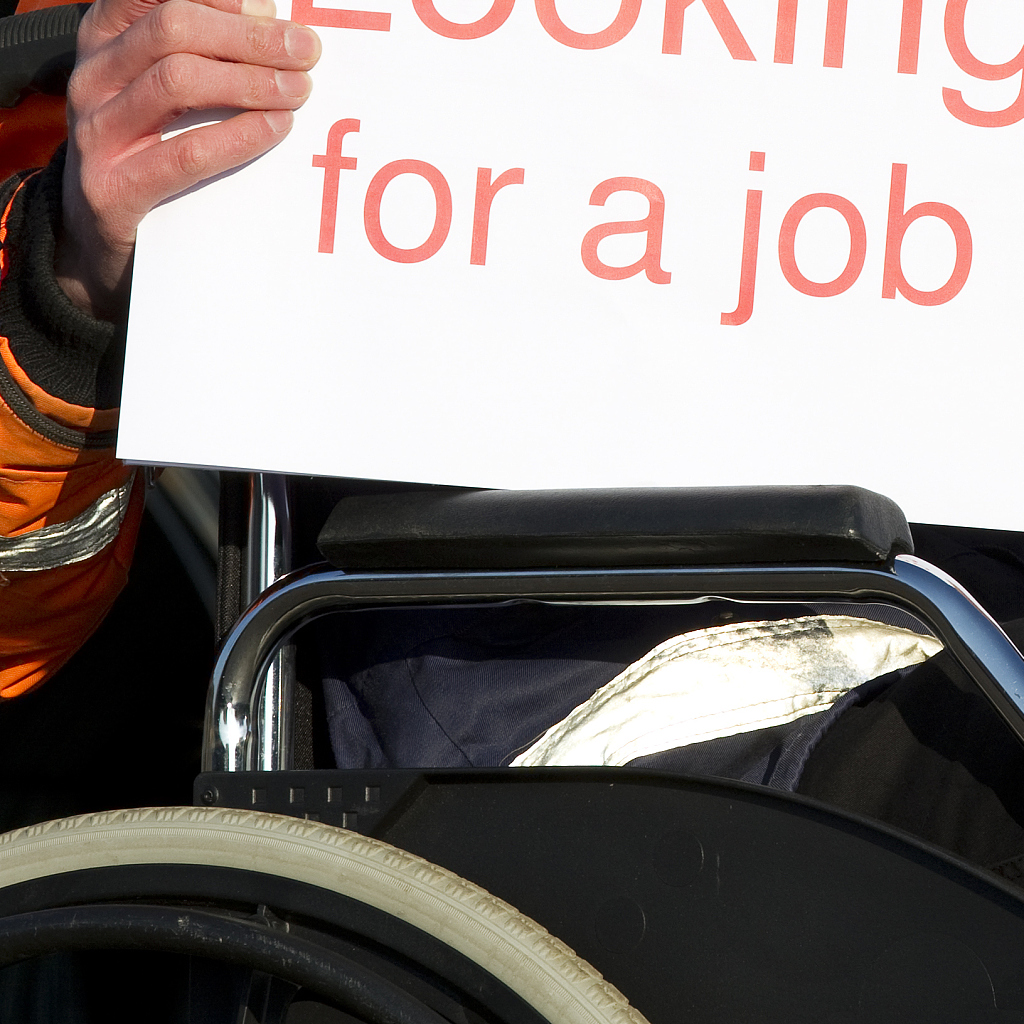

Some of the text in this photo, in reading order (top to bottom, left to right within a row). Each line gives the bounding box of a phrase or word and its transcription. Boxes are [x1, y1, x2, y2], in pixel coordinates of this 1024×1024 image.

[312, 117, 973, 327] for a job
